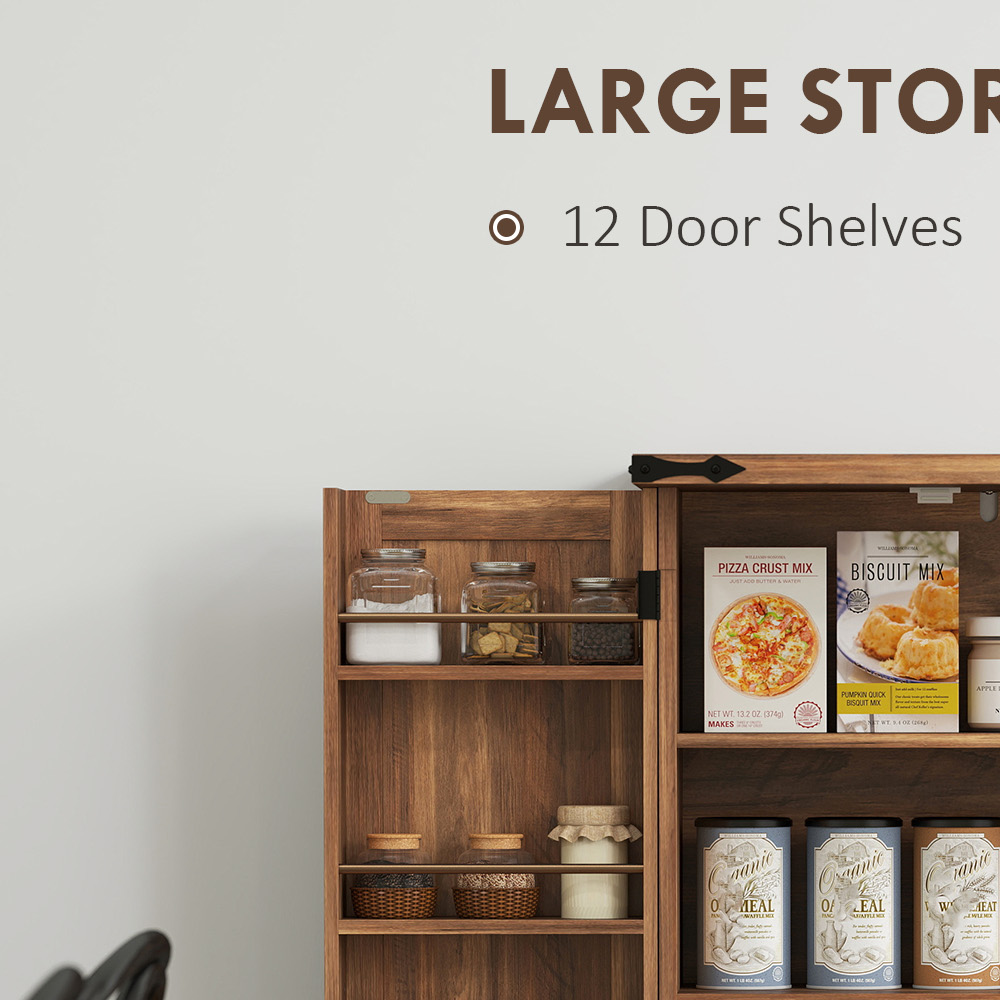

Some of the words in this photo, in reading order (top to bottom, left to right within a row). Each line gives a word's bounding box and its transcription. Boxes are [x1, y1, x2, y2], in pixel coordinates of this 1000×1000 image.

[718, 563, 749, 574] PIZZA
[752, 563, 789, 574] CRUST
[792, 563, 813, 574] MIX
[851, 563, 910, 580] BISCUIT
[919, 563, 944, 580] MIX
[764, 710, 784, 719] (374g)
